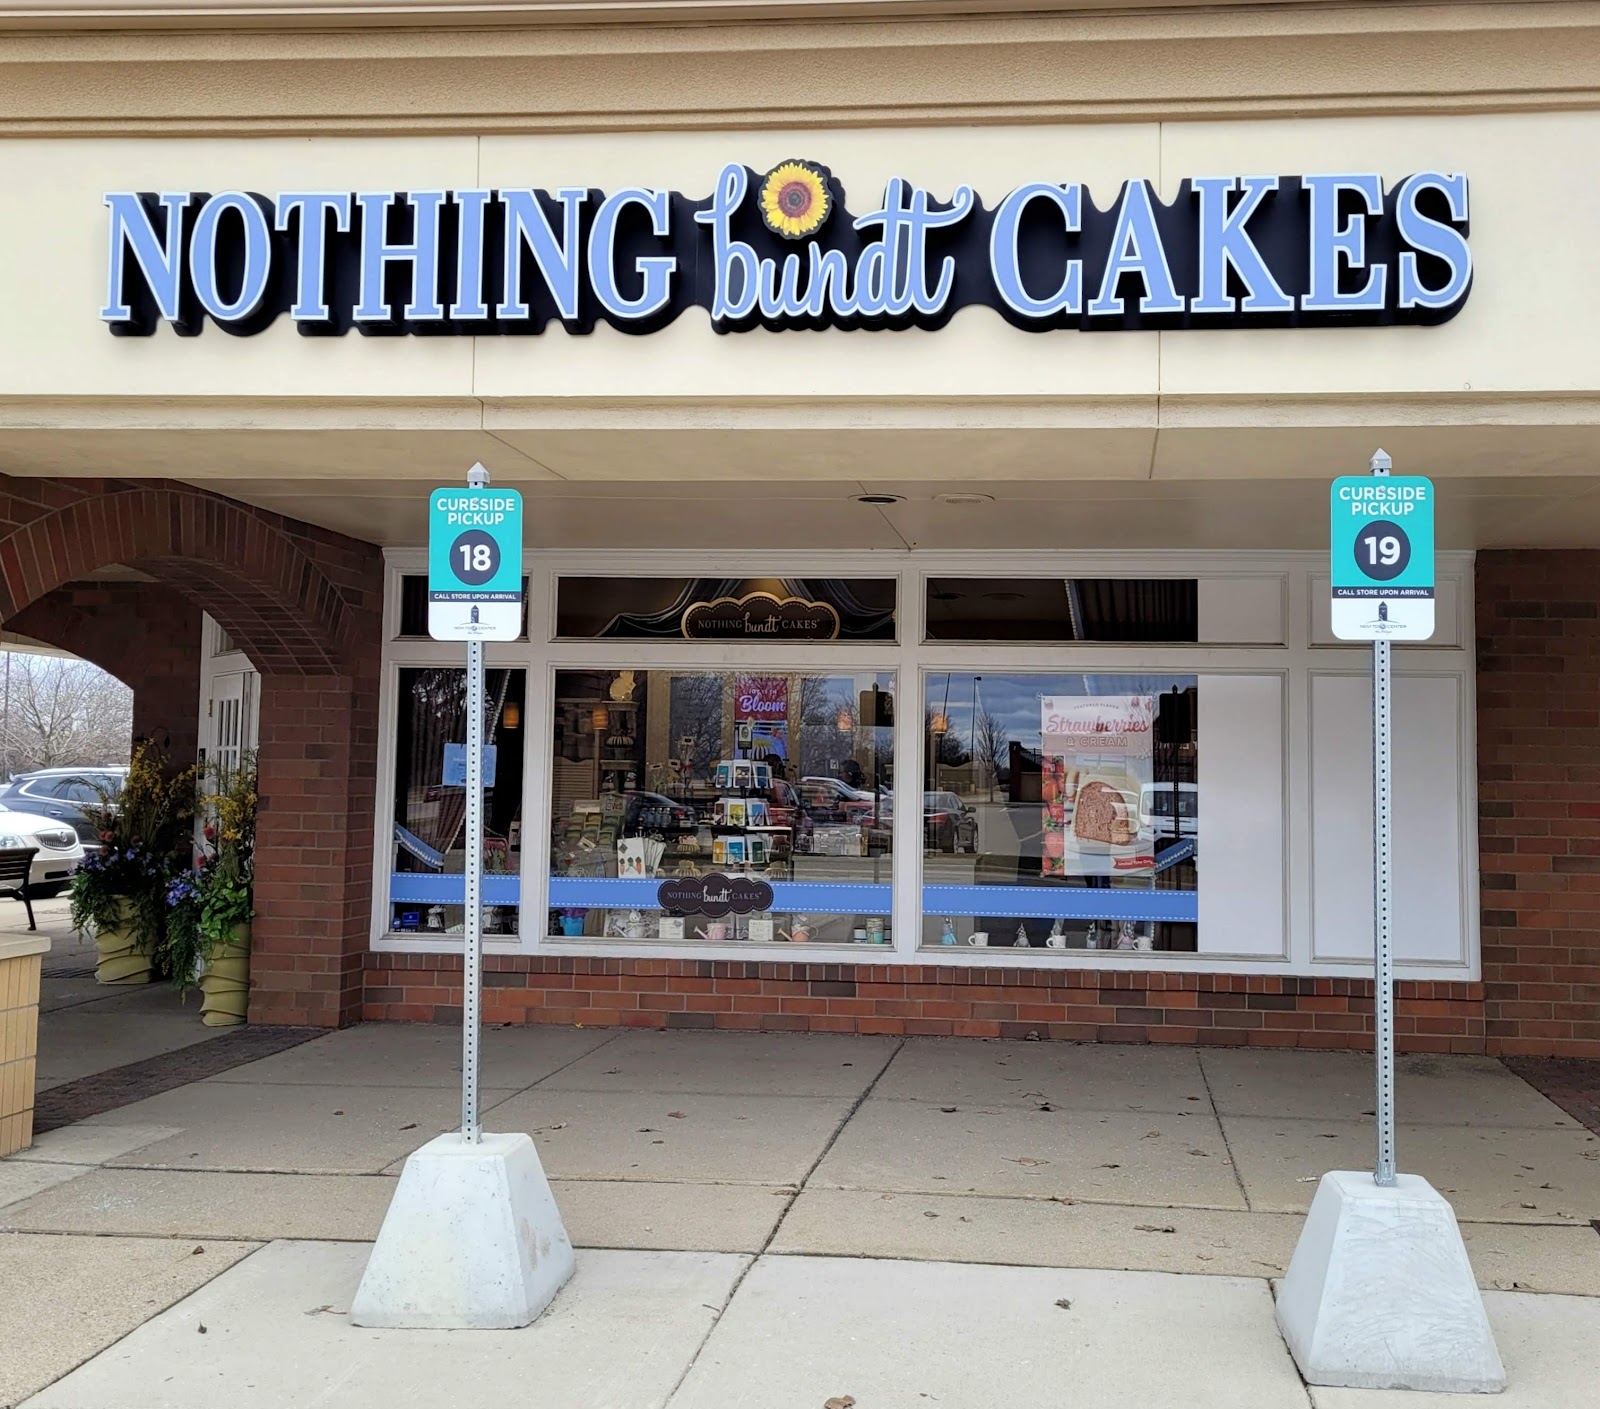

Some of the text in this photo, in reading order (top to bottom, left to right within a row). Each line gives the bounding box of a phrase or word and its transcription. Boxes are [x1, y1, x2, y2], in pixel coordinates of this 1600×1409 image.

[99, 161, 1473, 321] NOTHING bundt CAKES
[1339, 486, 1426, 500] CURBSIDE
[437, 497, 515, 511] CURBSIDE
[1351, 502, 1415, 516] PICKUP
[447, 512, 505, 525] PICKUP
[459, 544, 492, 572] 18
[1364, 536, 1401, 565] 19
[698, 611, 818, 633] NOTHING bundt CAKES
[740, 695, 786, 713] Bloom
[1046, 714, 1150, 733] Strawberries
[1066, 737, 1128, 747] & CREAM
[667, 885, 760, 902] NOTHING bundt CAKES
